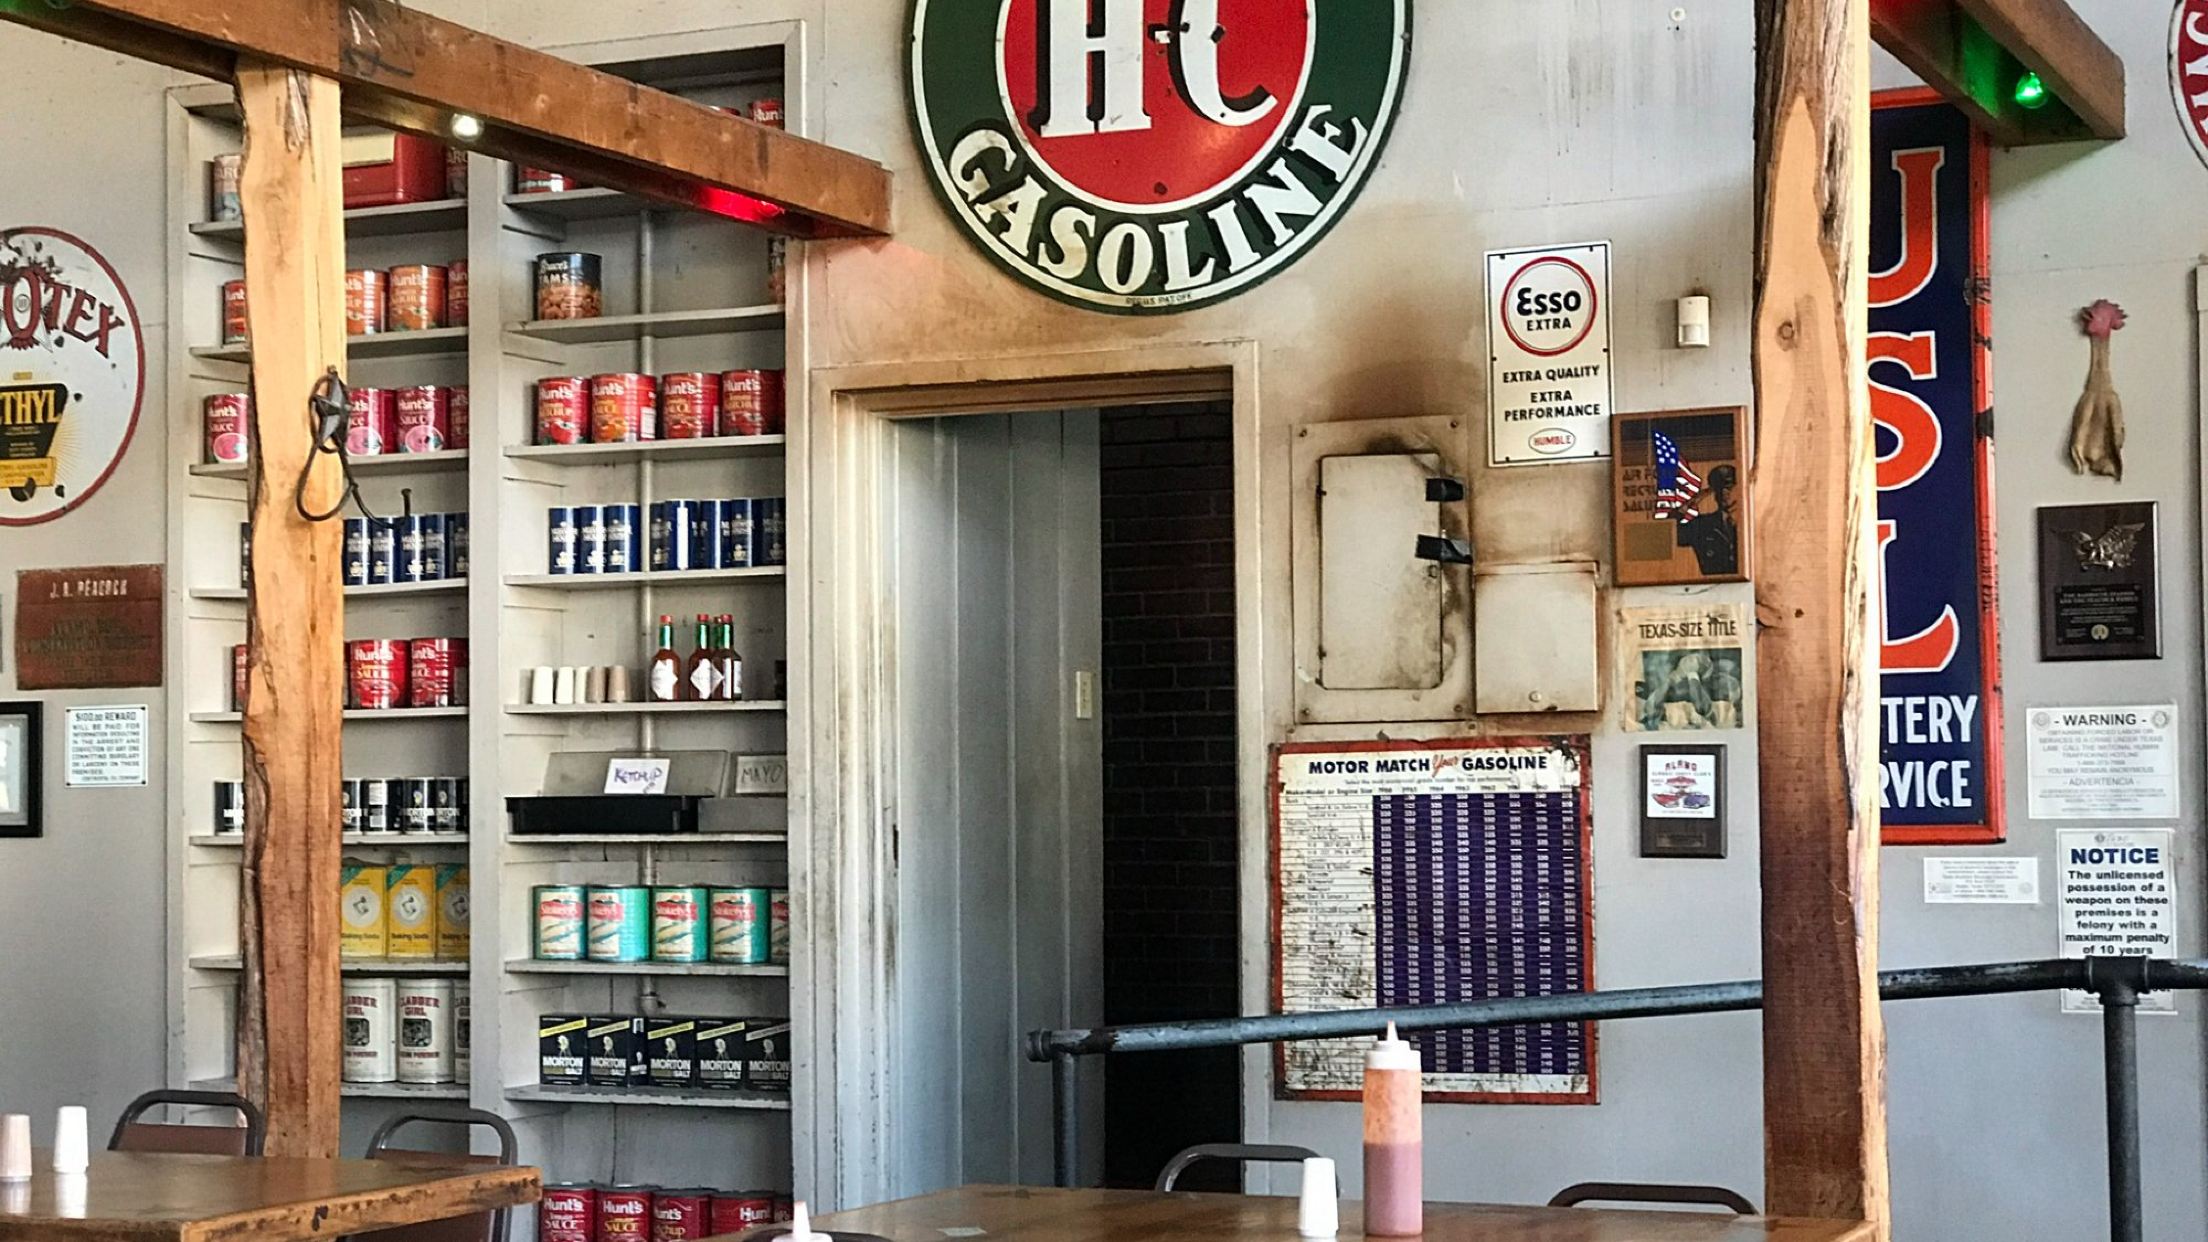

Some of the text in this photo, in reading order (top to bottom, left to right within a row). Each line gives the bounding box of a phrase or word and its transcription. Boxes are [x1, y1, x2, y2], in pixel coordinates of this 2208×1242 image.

[950, 104, 1368, 293] GASOLINE
[1527, 318, 1572, 331] EXTRA
[1503, 365, 1600, 383] EXTRA QUALITY
[1530, 390, 1572, 403] EXTRA
[0, 389, 61, 425] THYL
[1504, 404, 1600, 422] PERFORMANCE
[1533, 434, 1571, 446] HUMBLE
[78, 579, 128, 597] PEACOCK
[1638, 622, 1703, 639] TEXAS-SIZE
[105, 712, 136, 720] REWARD
[1880, 695, 1978, 744] TERY
[2063, 714, 2136, 726] WARNING
[1309, 760, 1369, 774] MOTOR
[1376, 759, 1430, 773] MATCH
[1462, 756, 1548, 771] GASOLINE
[2070, 848, 2159, 864] NOTICE
[2068, 870, 2164, 880] The unlicensed
[2067, 883, 2165, 893] possession of a
[2065, 895, 2168, 906] weapon on these
[2075, 908, 2158, 918] premises is a
[2077, 920, 2114, 931] felony
[2118, 920, 2146, 929] with
[2065, 932, 2169, 944] maximum penalty
[2082, 945, 2153, 956] of 10 years
[542, 1056, 584, 1067] MORTON
[590, 1057, 626, 1068] MORTON
[651, 1059, 691, 1070] MORTON
[700, 1059, 742, 1071] MORTON
[544, 1198, 584, 1212] Hunt's
[603, 1201, 644, 1214] Hunt's
[604, 1221, 638, 1232] SAUCE
